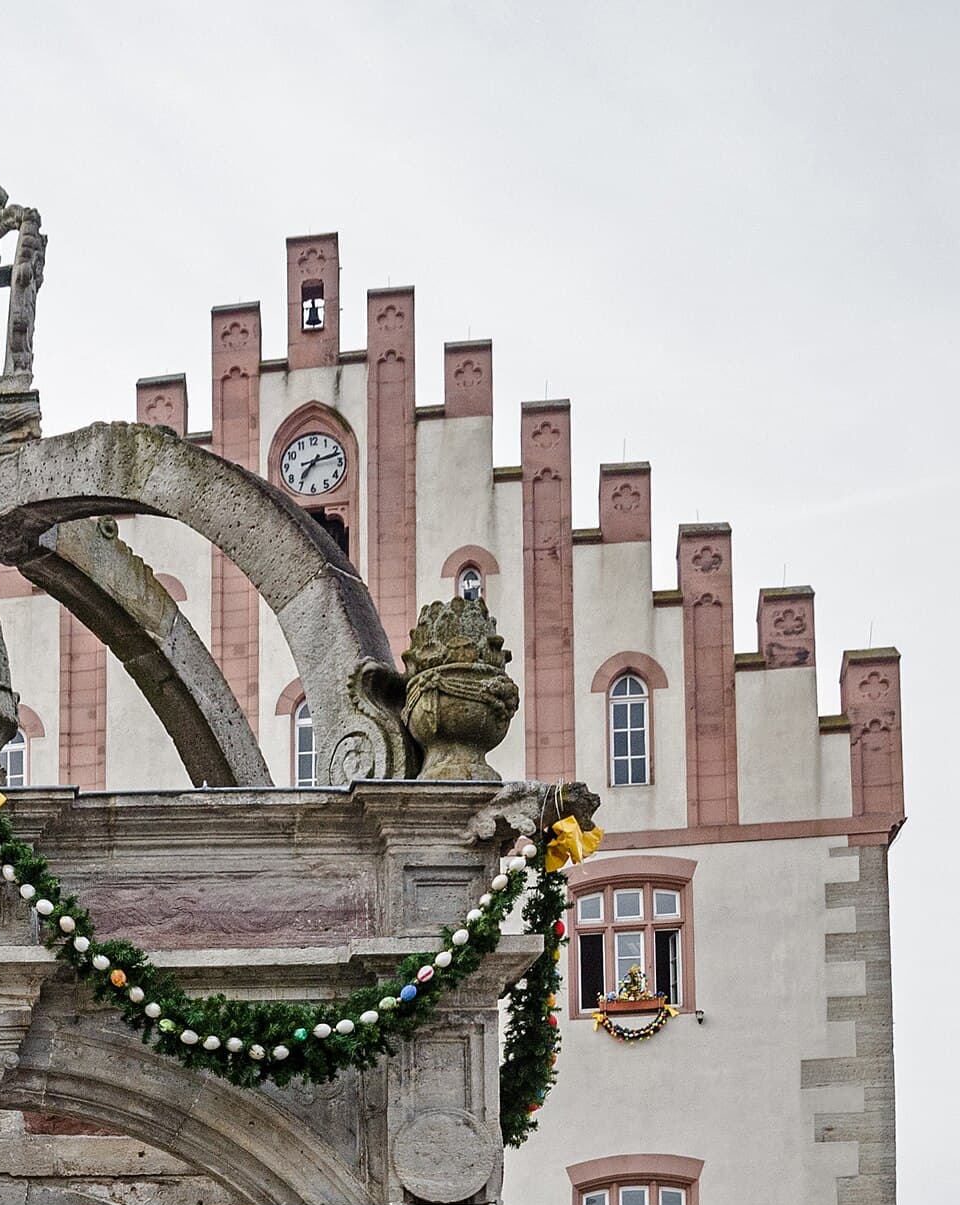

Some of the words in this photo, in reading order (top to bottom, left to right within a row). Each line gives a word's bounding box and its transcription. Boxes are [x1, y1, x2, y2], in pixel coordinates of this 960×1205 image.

[298, 442, 304, 450] 11
[309, 437, 318, 446] 12
[332, 445, 338, 454] 2
[288, 451, 296, 460] 10
[337, 458, 342, 466] 3
[284, 464, 289, 472] 9
[289, 475, 294, 483] 8
[332, 470, 338, 479] 4
[299, 481, 304, 491] 7
[311, 484, 316, 493] 6
[323, 480, 329, 489] 5
